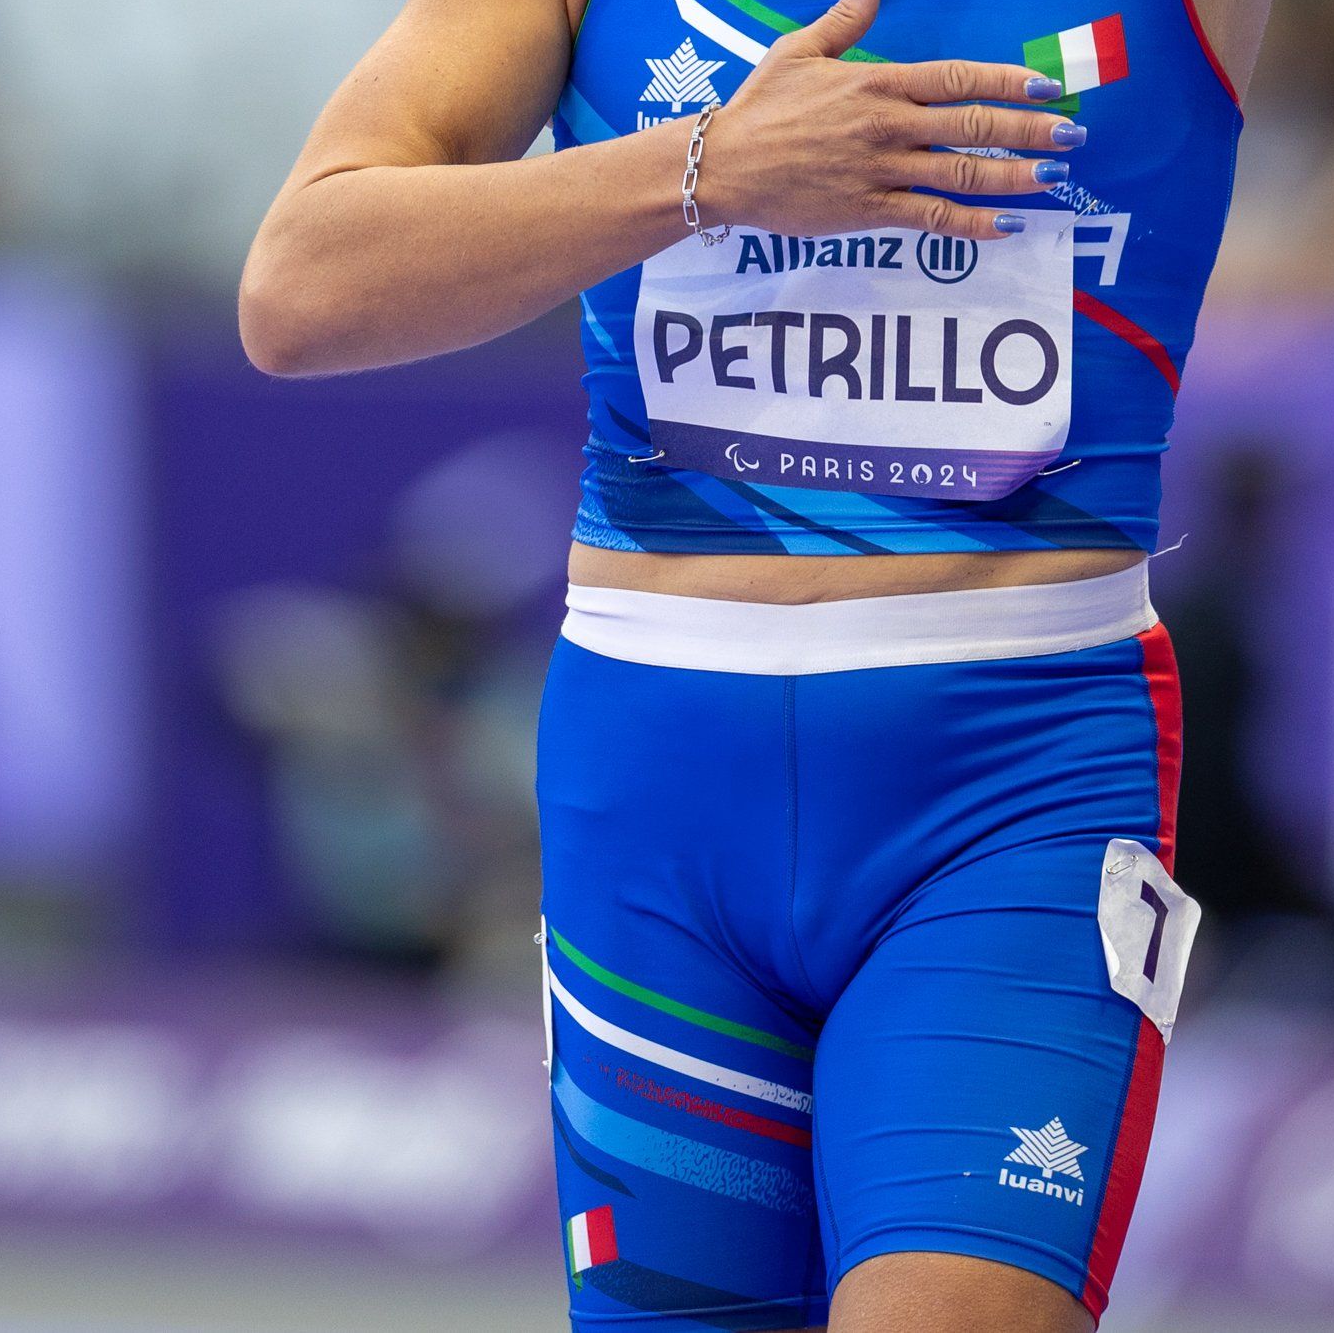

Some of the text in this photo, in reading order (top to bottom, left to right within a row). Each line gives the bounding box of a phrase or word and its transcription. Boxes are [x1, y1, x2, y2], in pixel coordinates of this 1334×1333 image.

[735, 233, 904, 275] Allianz
[653, 309, 1060, 406] PETRILLO
[889, 462, 977, 488] 2024
[1139, 879, 1170, 985] 7
[998, 1168, 1084, 1207] luanvi
